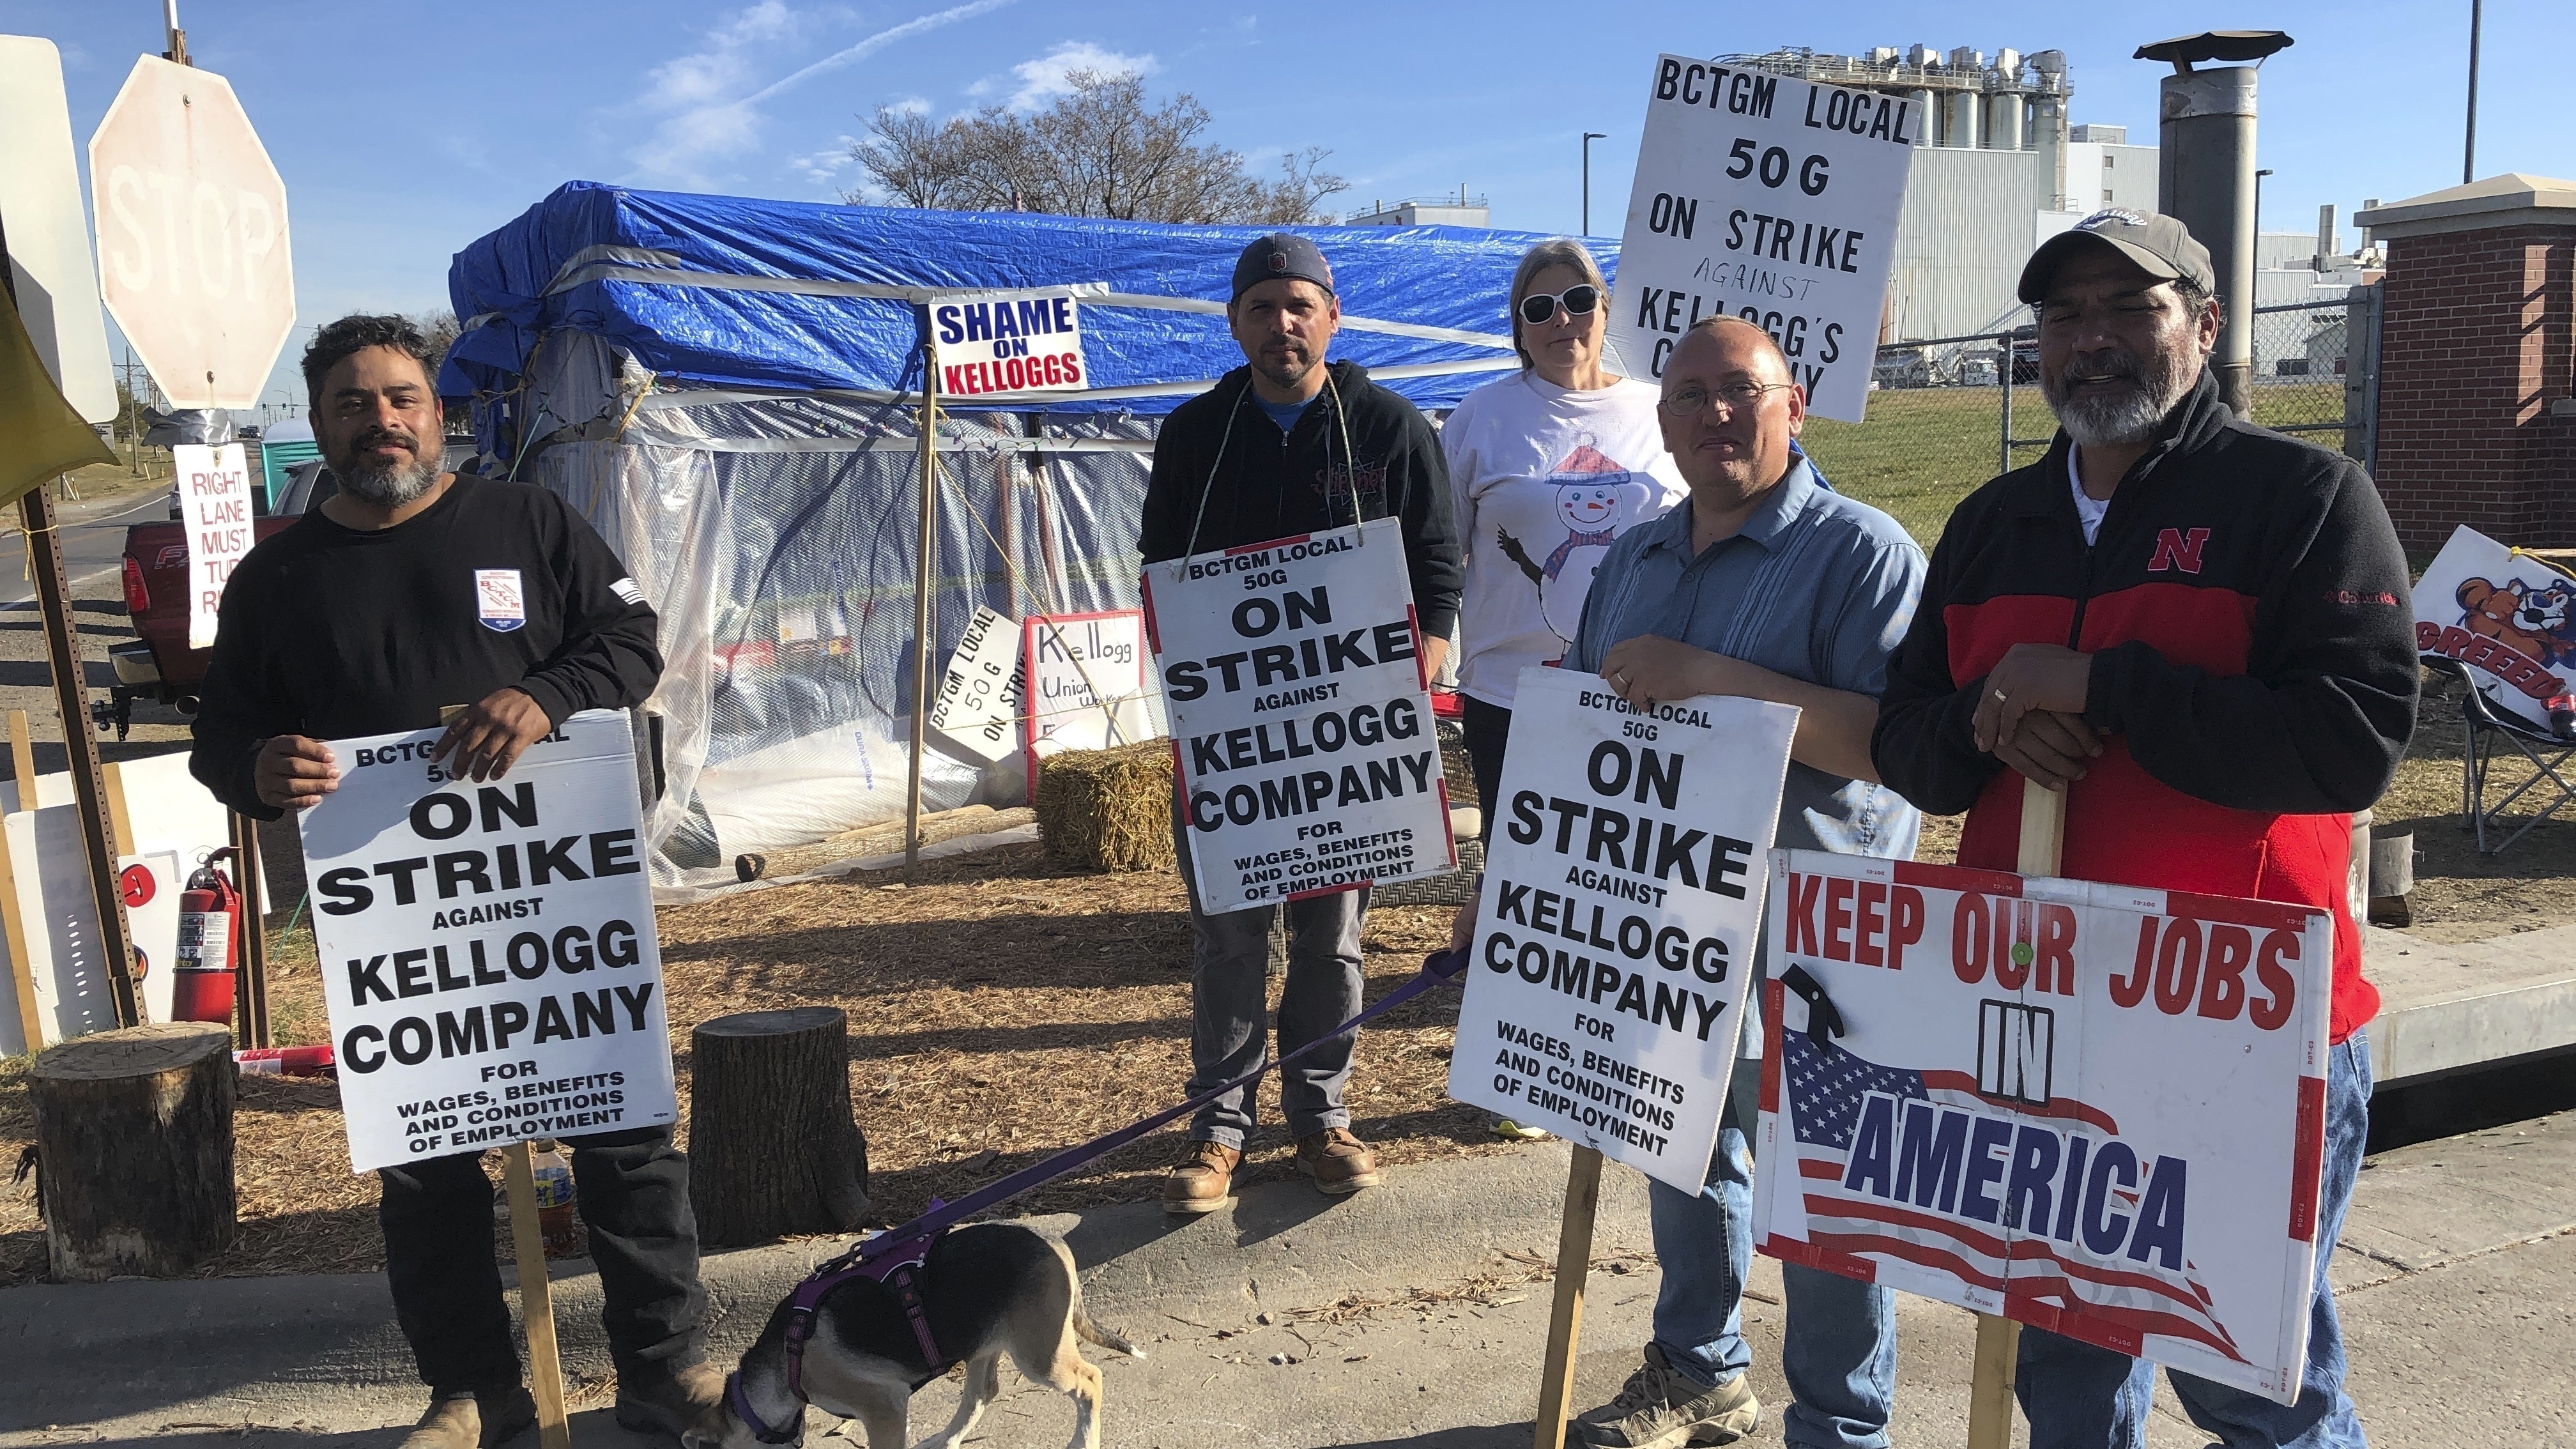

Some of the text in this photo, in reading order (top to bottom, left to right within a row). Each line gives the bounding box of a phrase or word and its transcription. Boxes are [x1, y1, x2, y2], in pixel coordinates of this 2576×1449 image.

[1657, 59, 1911, 145] BCTGM LOCAL
[108, 164, 275, 302] STOP
[1649, 192, 1864, 273] ON STRIKE
[1694, 257, 1819, 301] AGAINST
[937, 297, 1073, 344] SHAME
[993, 338, 1029, 358] ON
[945, 353, 1080, 395] KELLOGGS
[192, 471, 241, 496] RIGHT
[200, 500, 245, 525] LANE
[202, 528, 247, 555] MUST
[1188, 536, 1353, 580] BCTGM LOCAL
[2147, 528, 2211, 574] N
[1243, 569, 1288, 590] 50G
[1232, 585, 1332, 638] ON
[1039, 621, 1131, 663] Kellogg
[1165, 620, 1417, 702] STRIKE
[932, 611, 996, 728] BCTGM LOCAL
[1043, 676, 1092, 698] Union
[983, 715, 1007, 742] ON
[999, 651, 1027, 708] STRIK
[1253, 682, 1340, 713] AGAINST
[1579, 691, 1712, 729] BCTGM LOCAL
[356, 740, 435, 767] BCTG
[1190, 698, 1420, 776] KELLOGG
[1622, 720, 1658, 741] 50G
[1190, 750, 1433, 832] COMPANY
[1587, 740, 1685, 811] ON
[410, 782, 539, 840] ON
[1297, 820, 1344, 841] FOR
[1234, 829, 1413, 871] WAGES, BENEFITS
[1241, 845, 1414, 886] AND CONDITIONS
[1507, 790, 1753, 900] STRIKE
[318, 829, 641, 916] STRIKE
[1245, 860, 1415, 901] OF EMPLOYMENT
[1565, 866, 1667, 908] AGAINST
[433, 897, 544, 930] AGAINST
[1496, 880, 1729, 985] KELLOGG
[2287, 917, 2306, 926] OT-C2
[347, 919, 640, 1006] KELLOGG
[1786, 873, 2301, 1031] KEEP OUR JOBS
[1484, 931, 1728, 1043] COMPANY
[342, 983, 654, 1073] COMPANY
[1574, 1013, 1614, 1043] FOR
[481, 1061, 539, 1083] FOR
[1497, 1020, 1685, 1105] WAGES, BENEFITS
[1976, 998, 2054, 1108] IN
[396, 1071, 625, 1119] WAGES, BENEFITS
[1495, 1048, 1675, 1131] AND CONDITIONS
[405, 1090, 624, 1137] AND CONDITIONS
[409, 1108, 625, 1153] OF EMPLOYMENT
[1493, 1074, 1669, 1158] OF EMPLOYMENT
[1844, 1096, 2188, 1271] AMERICA
